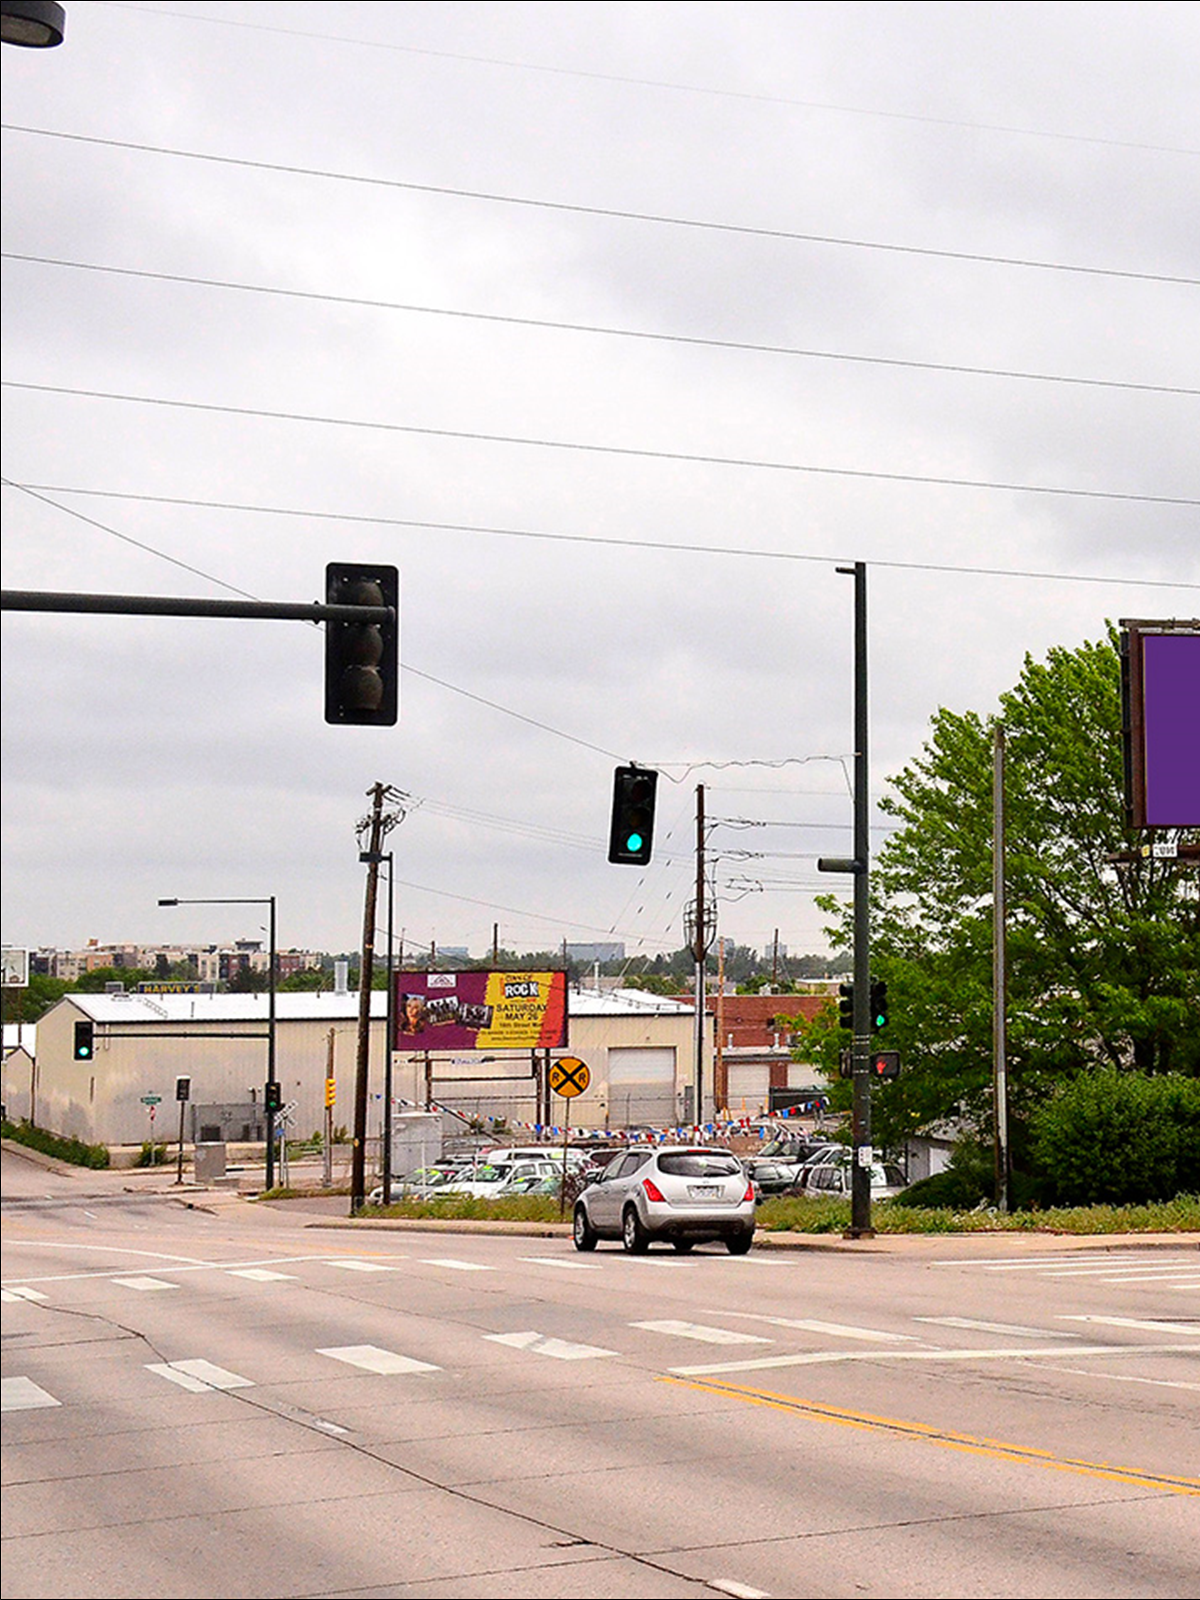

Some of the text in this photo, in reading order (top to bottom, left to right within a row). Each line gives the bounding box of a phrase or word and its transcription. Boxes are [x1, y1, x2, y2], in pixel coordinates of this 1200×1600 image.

[505, 982, 538, 997] ROCK
[496, 1003, 547, 1013] SATURDAY
[552, 1072, 560, 1084] R
[578, 1072, 586, 1084] R
